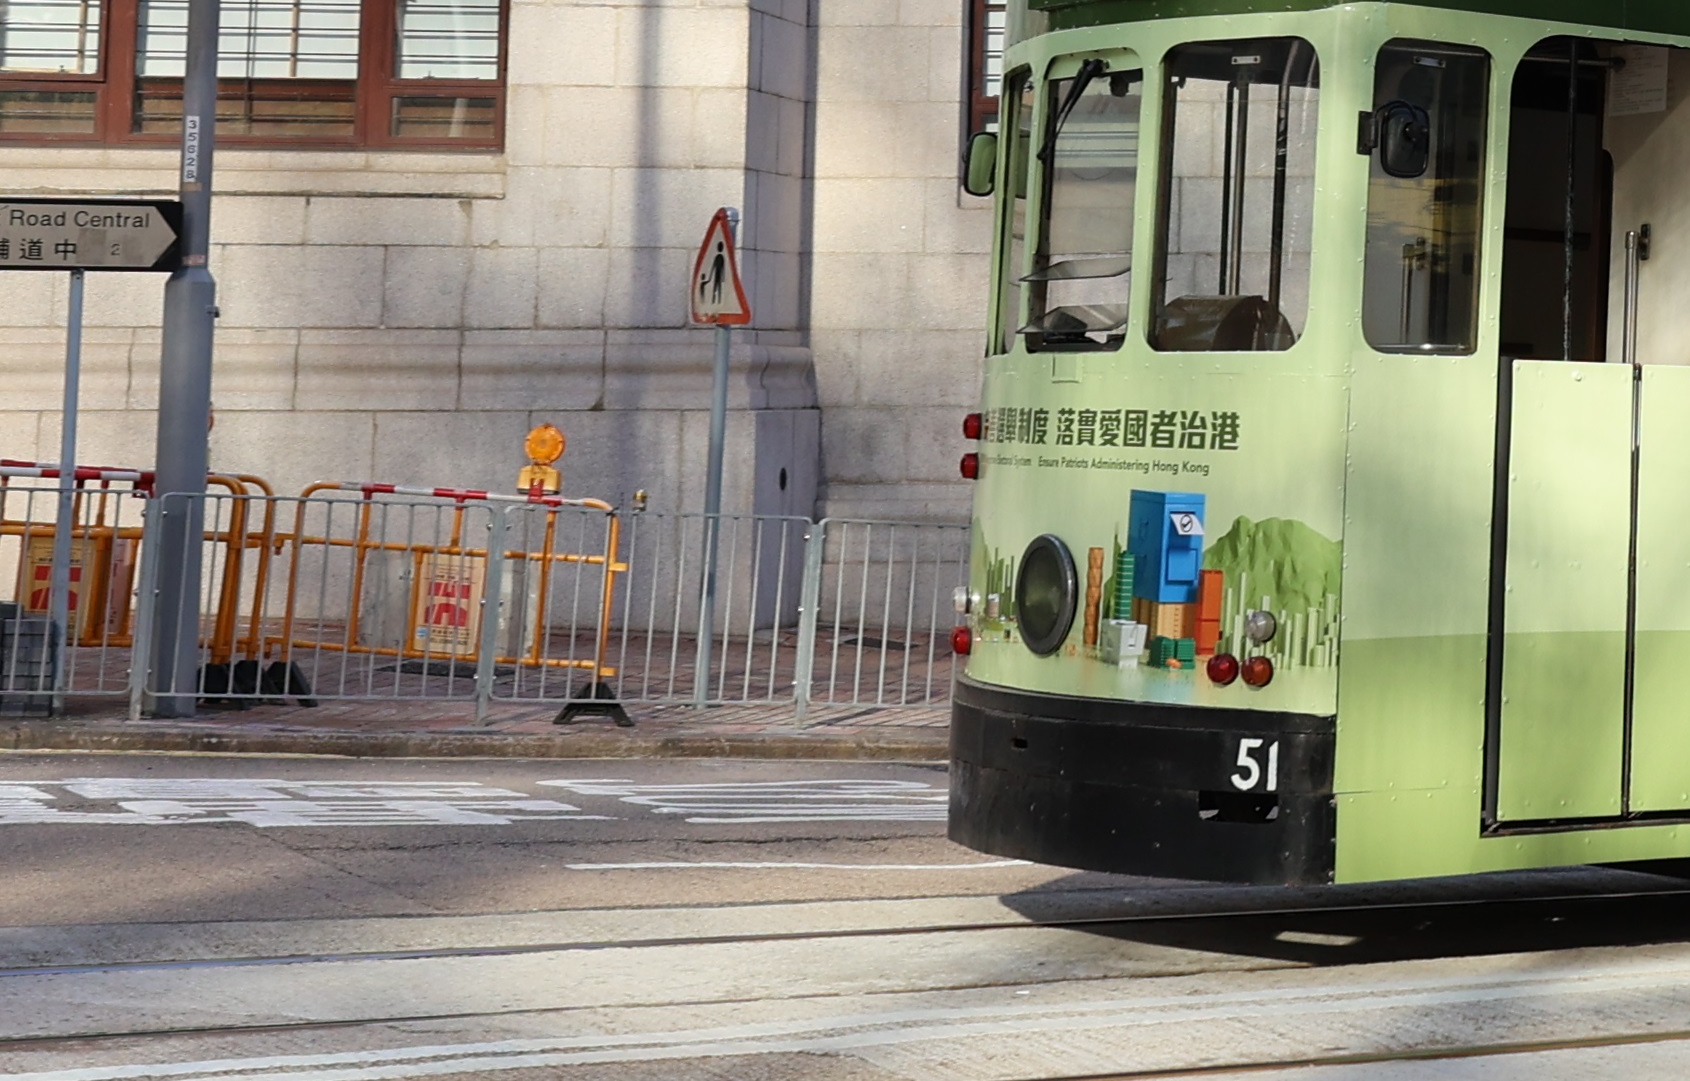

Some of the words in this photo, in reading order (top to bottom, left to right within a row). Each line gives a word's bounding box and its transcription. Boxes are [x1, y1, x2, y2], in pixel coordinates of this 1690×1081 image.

[185, 119, 198, 179] 35628
[9, 209, 66, 227] Road
[74, 210, 150, 229] Central
[1055, 407, 1241, 451] 落實愛國者治港
[1037, 456, 1060, 468] Ensure
[1061, 457, 1089, 469] Patriots
[1090, 458, 1150, 474] Administering
[1152, 460, 1179, 475] Hong
[1182, 461, 1210, 477] Kong
[1230, 737, 1280, 792] 51
